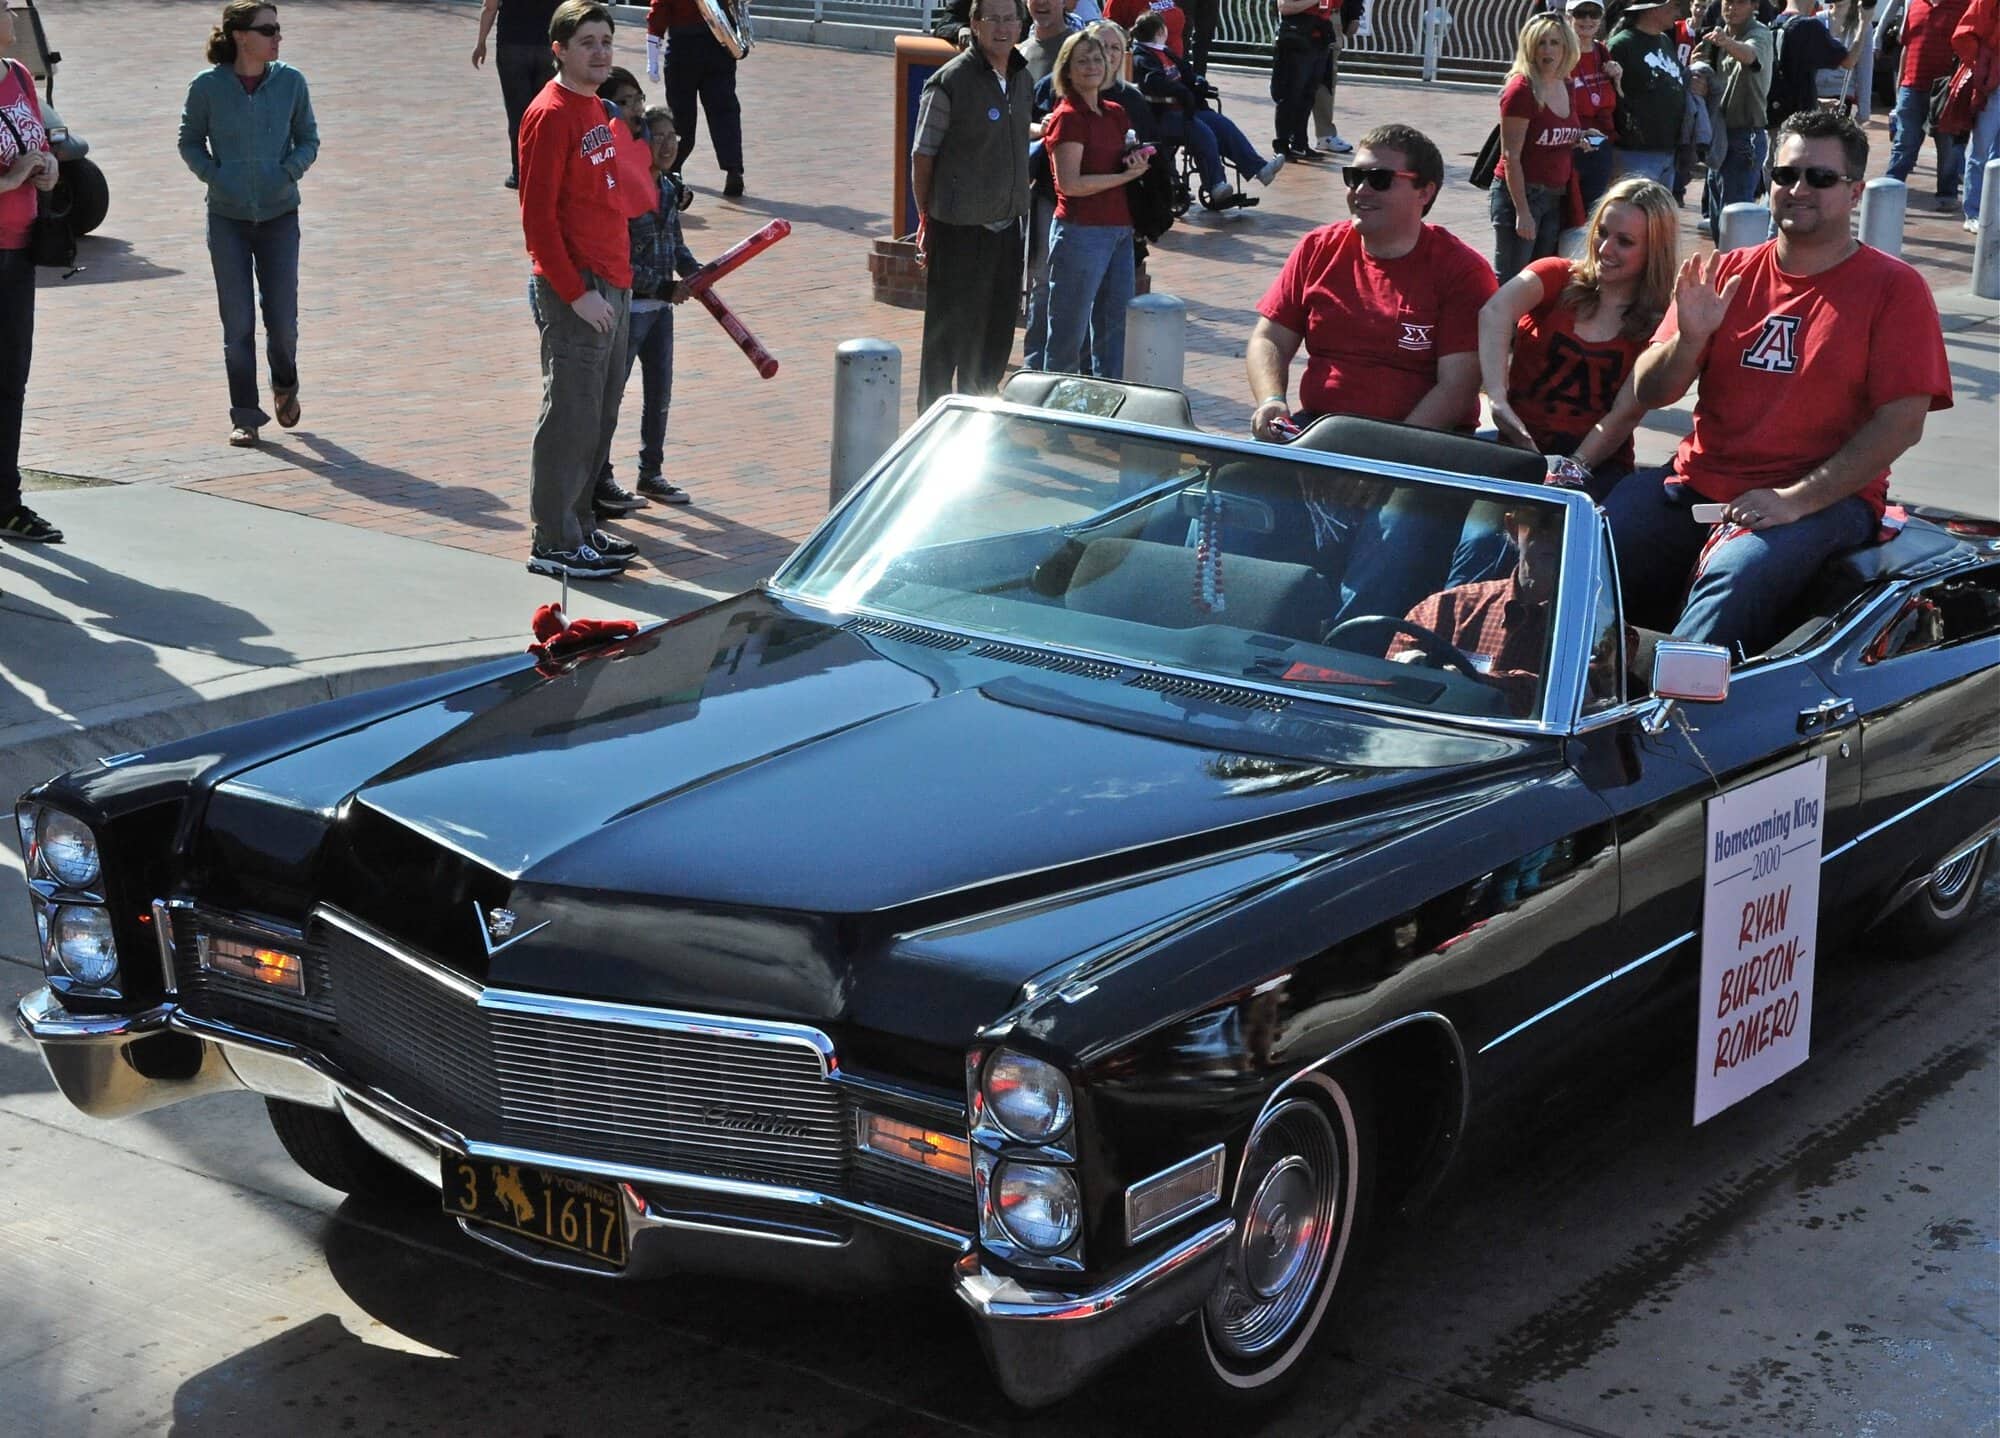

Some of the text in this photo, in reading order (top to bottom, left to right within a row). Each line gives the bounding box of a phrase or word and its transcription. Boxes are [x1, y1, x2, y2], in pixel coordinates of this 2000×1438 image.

[1740, 313, 1802, 374] A
[1714, 796, 1819, 864] Homecoming King
[1751, 844, 1781, 881] 2000
[1738, 884, 1792, 951] RYAN
[1717, 935, 1806, 1019] BURTON-
[1713, 990, 1799, 1078] ROMERO
[457, 1164, 616, 1255] 3 1617
[538, 1170, 615, 1207] WYOMING
